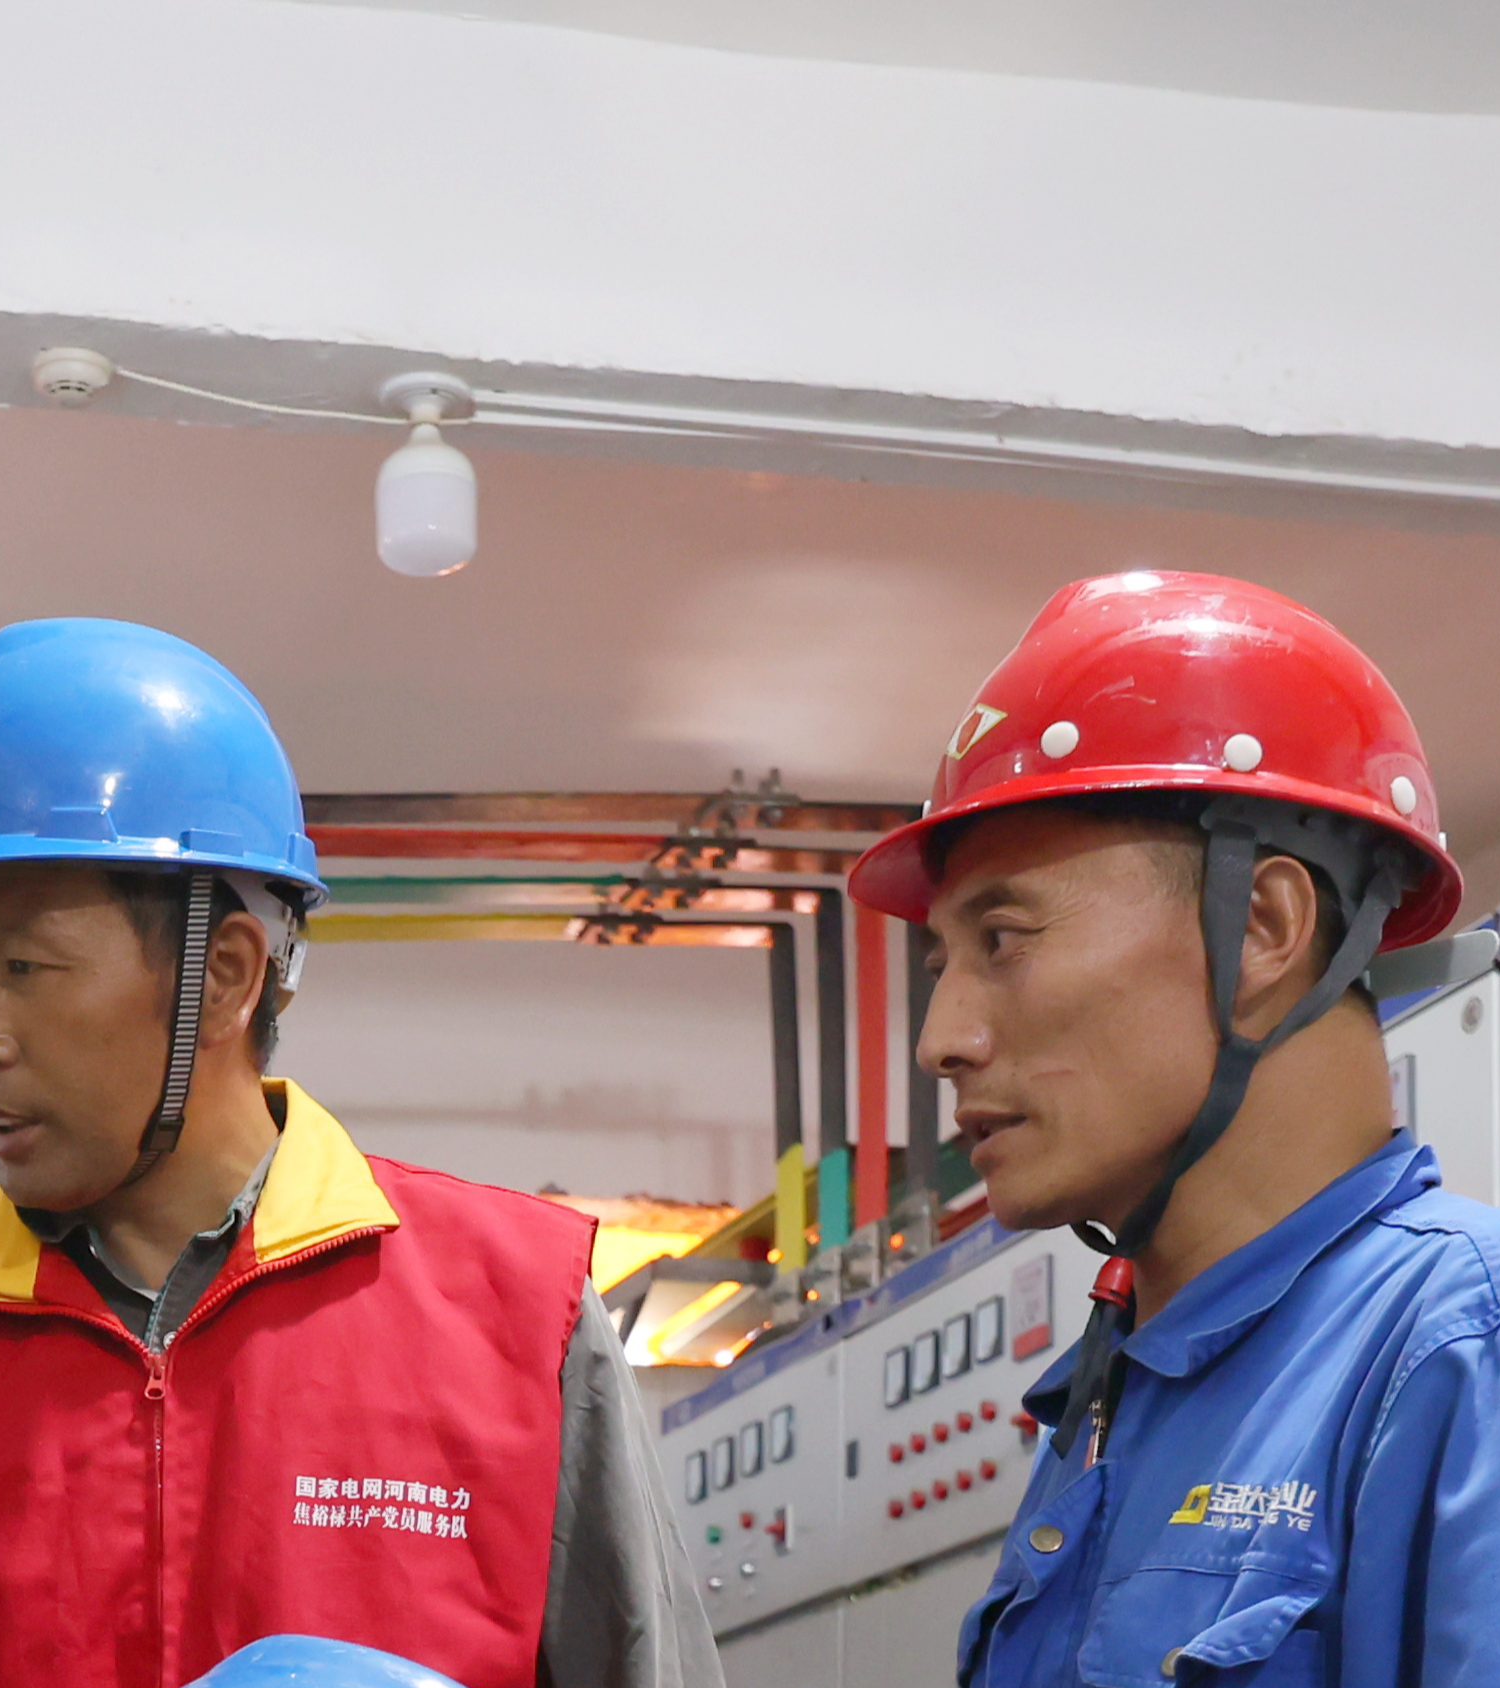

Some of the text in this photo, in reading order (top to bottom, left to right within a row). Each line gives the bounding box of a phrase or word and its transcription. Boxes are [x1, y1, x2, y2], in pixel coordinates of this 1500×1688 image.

[295, 1475, 471, 1511] 国家电网河南电力
[292, 1501, 469, 1540] 焦裕禄共产党员服务队
[1287, 1513, 1313, 1532] YE
